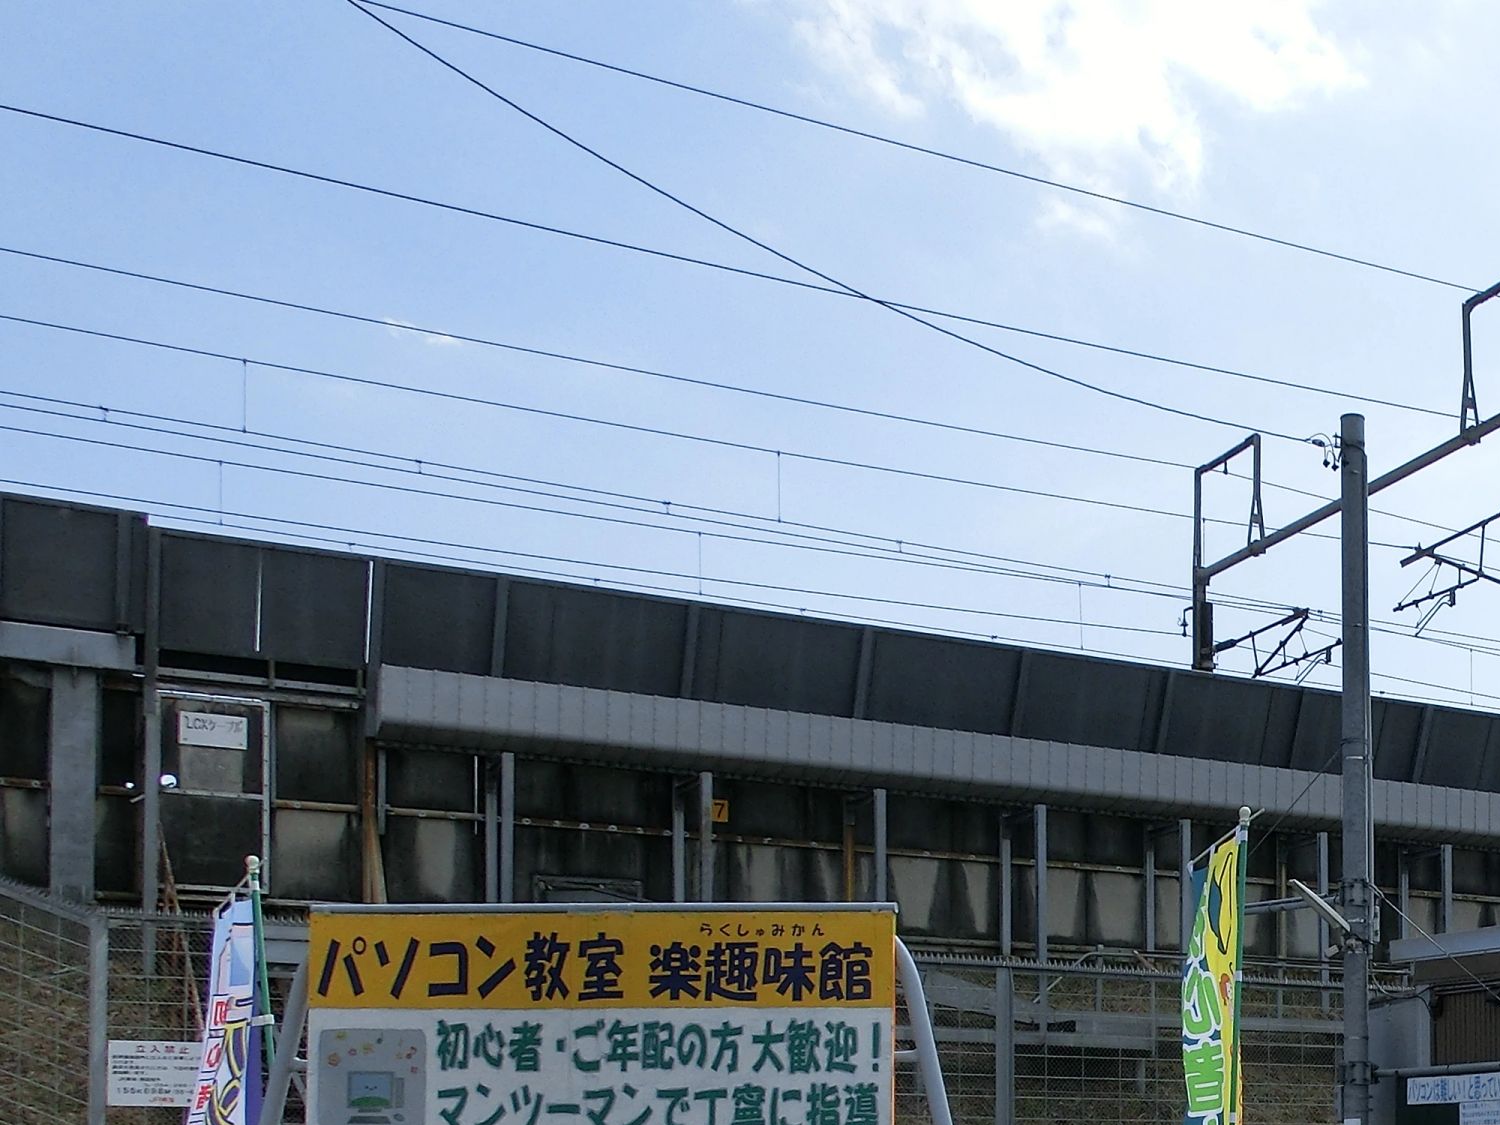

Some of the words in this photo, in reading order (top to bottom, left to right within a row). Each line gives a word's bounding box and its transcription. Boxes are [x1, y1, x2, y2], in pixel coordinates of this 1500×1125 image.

[713, 802, 725, 818] 7
[700, 923, 825, 937] らくしゅみかん
[317, 931, 625, 1000] パソコン教室
[649, 941, 873, 1001] 楽趣味館
